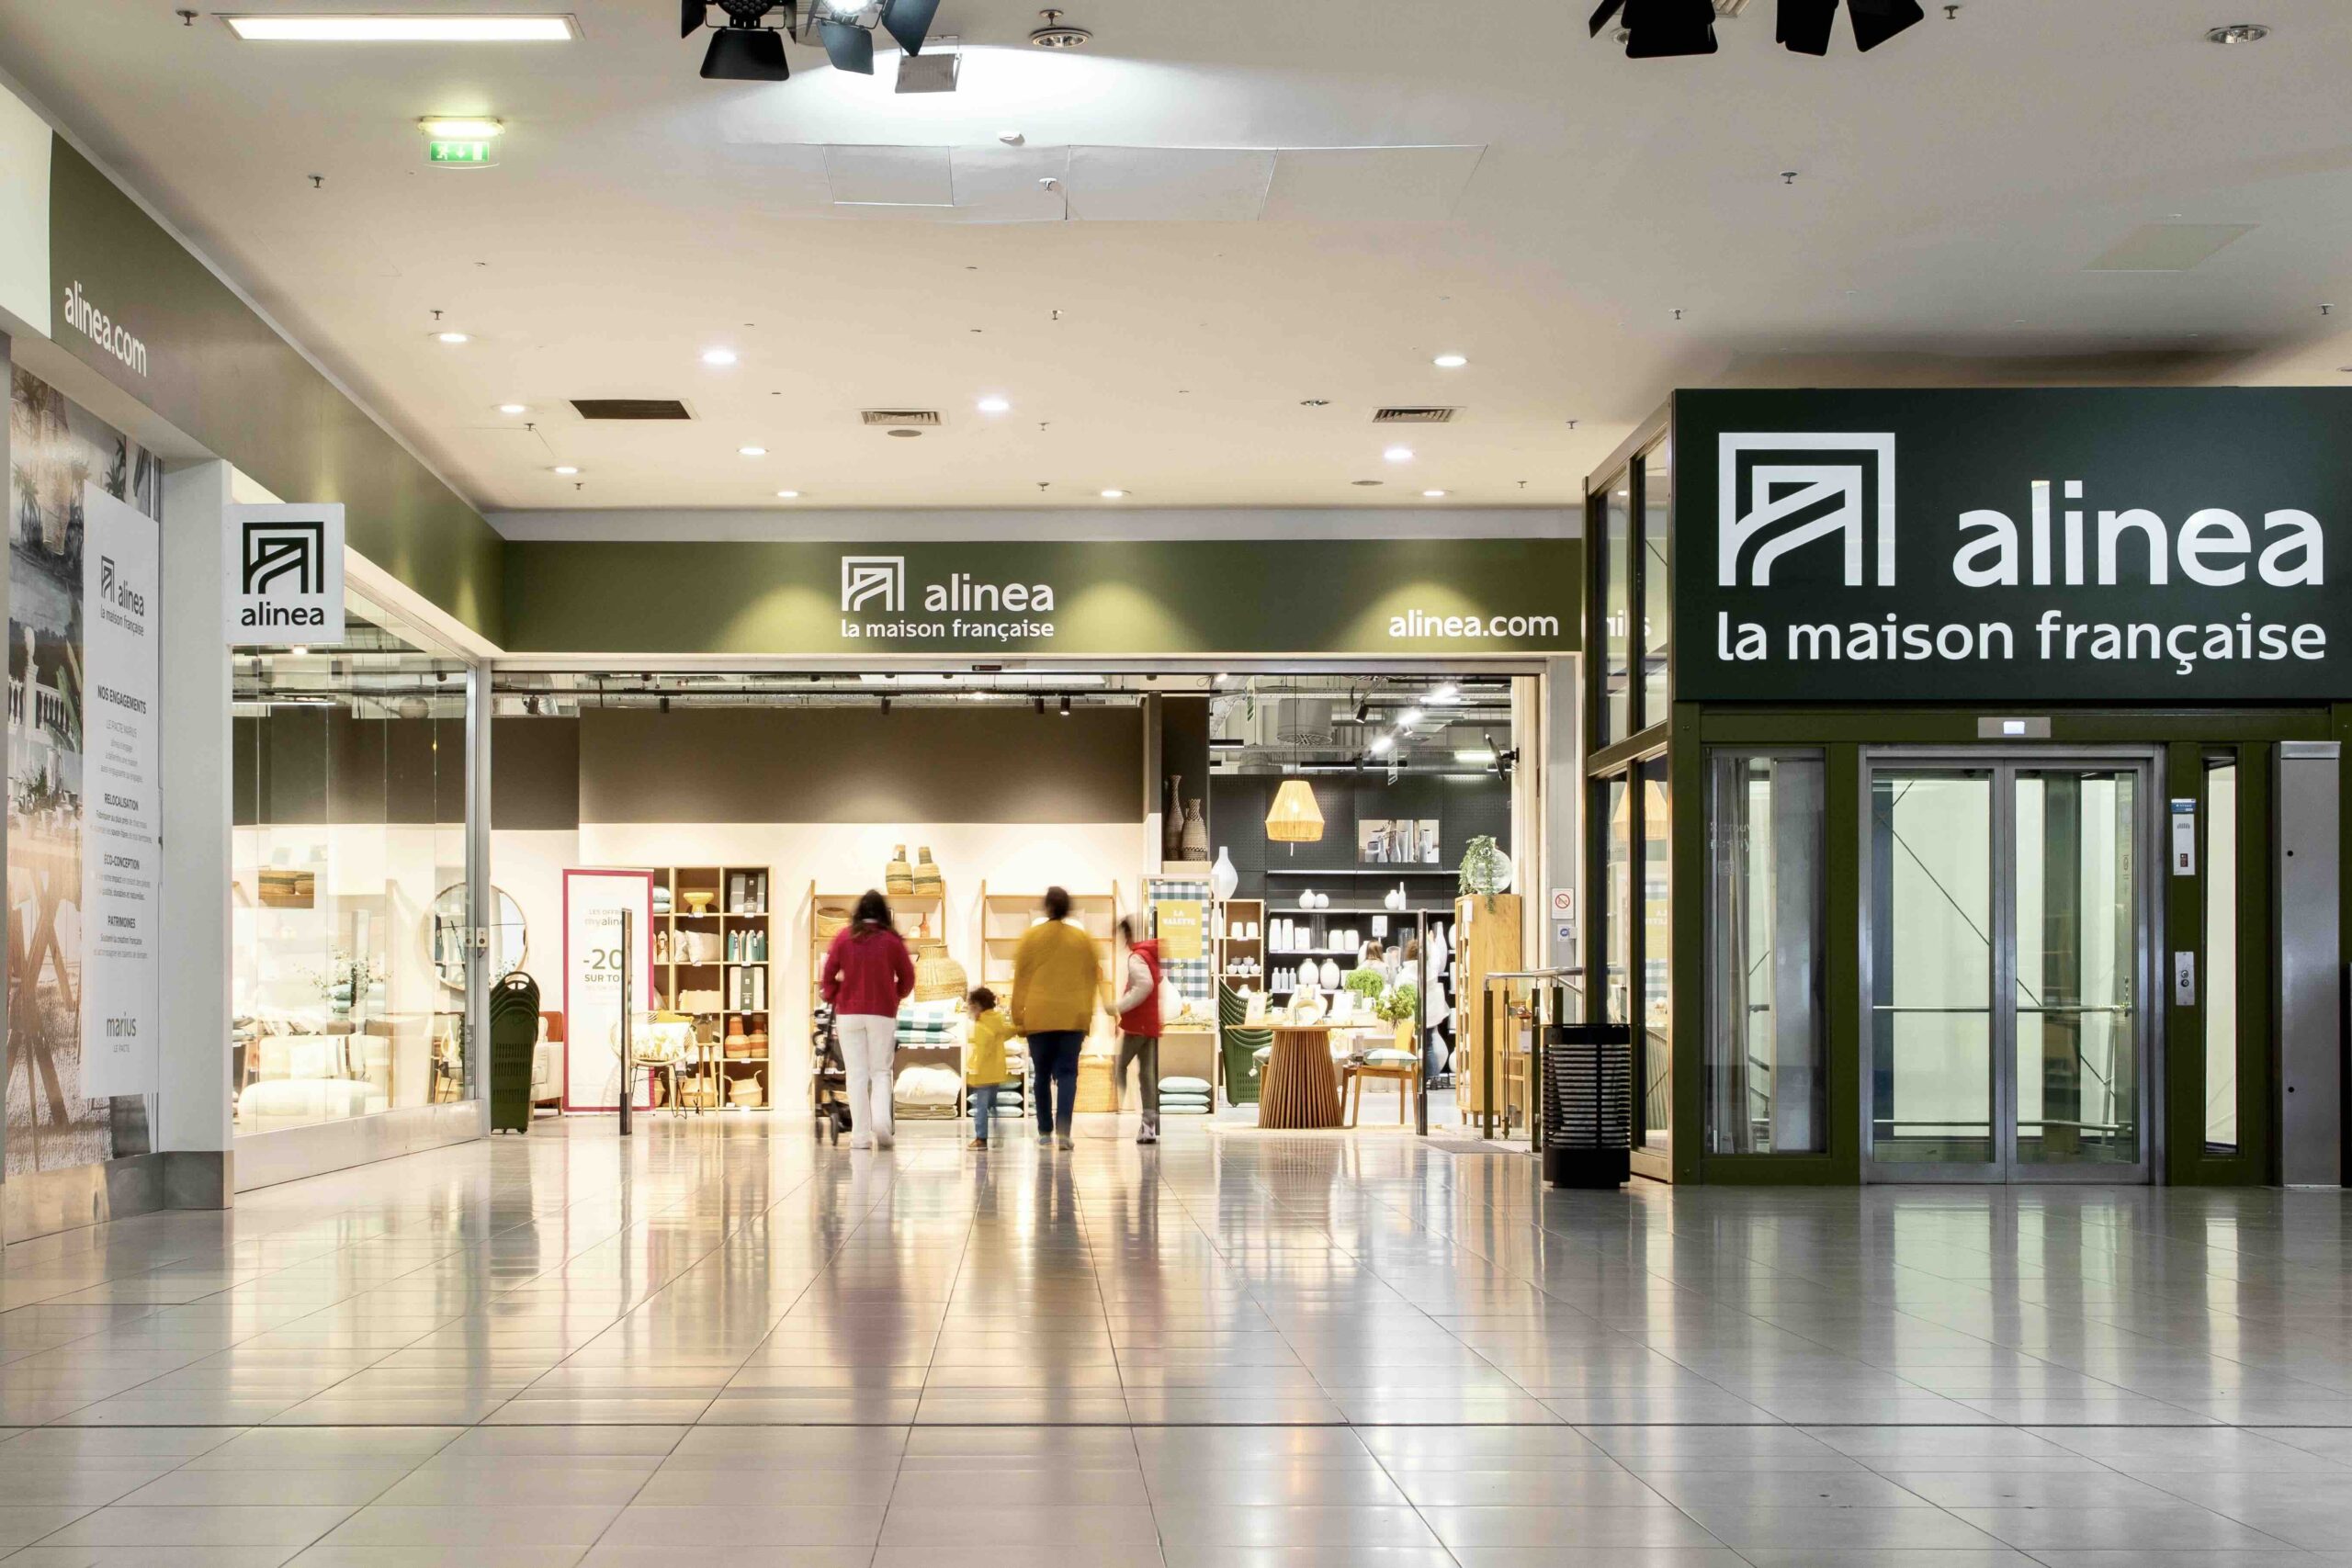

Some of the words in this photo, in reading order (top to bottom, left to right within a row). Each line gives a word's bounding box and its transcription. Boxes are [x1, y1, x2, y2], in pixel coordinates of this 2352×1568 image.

[65, 280, 147, 378] alinea.com
[1952, 480, 2324, 587] alinea
[118, 580, 144, 616] alinea
[924, 573, 1054, 612] alinea
[106, 610, 123, 626] maison
[124, 615, 144, 637] française
[241, 602, 324, 626] alinea
[1388, 609, 1559, 637] alinea.com
[842, 619, 859, 637] la
[866, 620, 944, 637] maison
[952, 619, 1054, 642] française
[1719, 612, 1767, 660] la
[1789, 613, 2014, 660] maison
[2036, 610, 2326, 675] française
[97, 684, 109, 702] NOS
[110, 689, 147, 715] ENGAGEMENTS
[104, 793, 139, 811] RELOCALISATION
[107, 915, 136, 929] PATRIMOINES
[584, 916, 622, 927] myalin
[584, 974, 605, 982] SUR
[106, 1010, 137, 1037] marius
